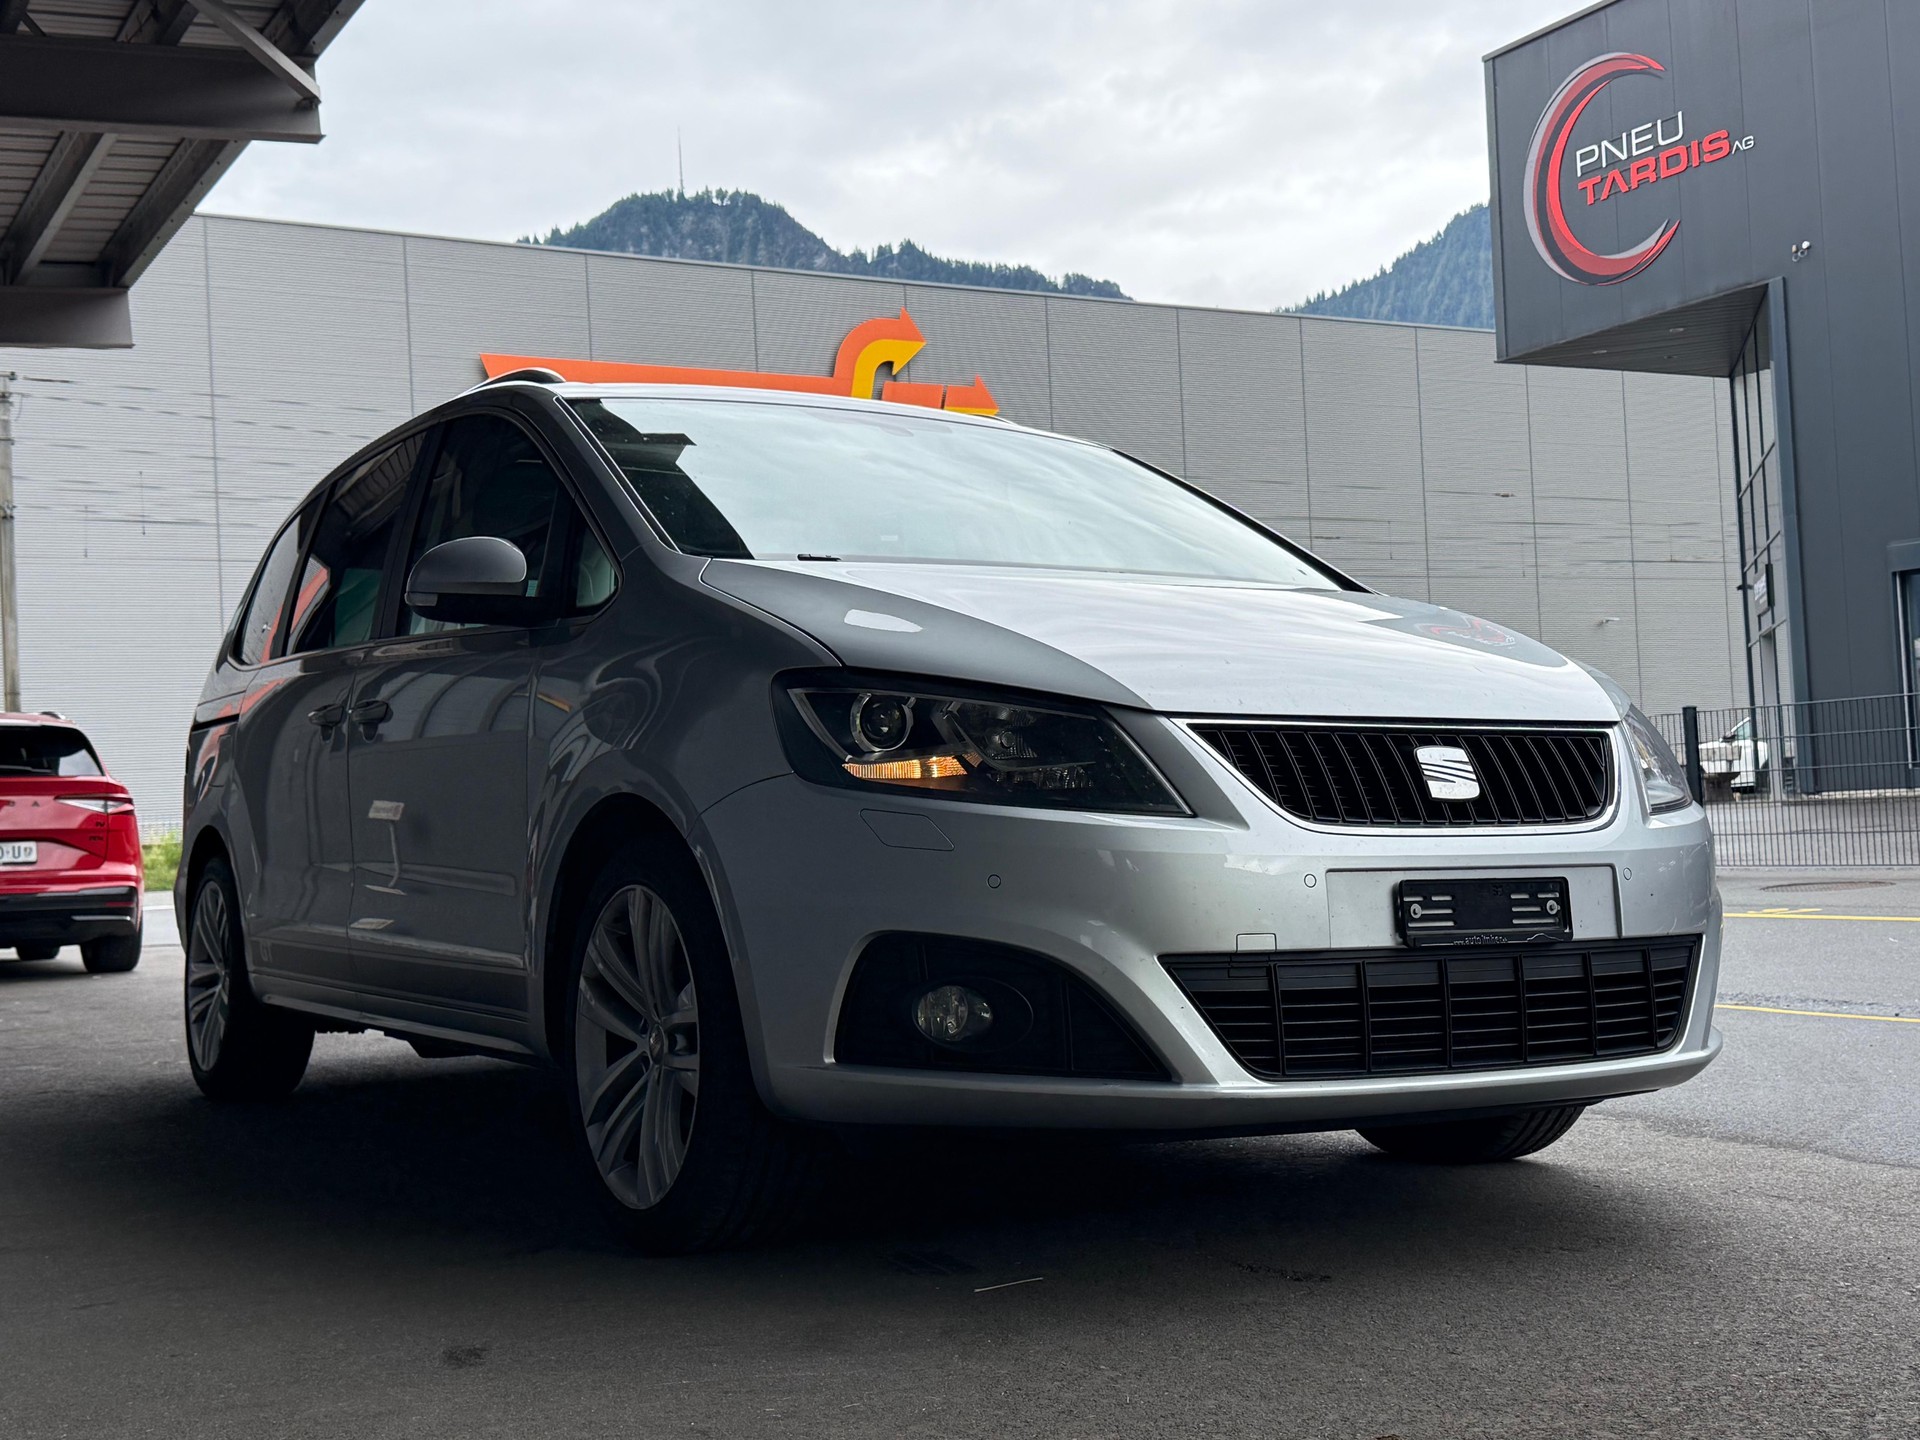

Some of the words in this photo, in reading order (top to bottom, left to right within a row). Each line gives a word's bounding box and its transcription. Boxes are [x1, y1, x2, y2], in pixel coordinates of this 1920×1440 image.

[1576, 111, 1684, 178] PNEU
[1578, 129, 1732, 206] TARDIS
[1731, 135, 1755, 155] AG
